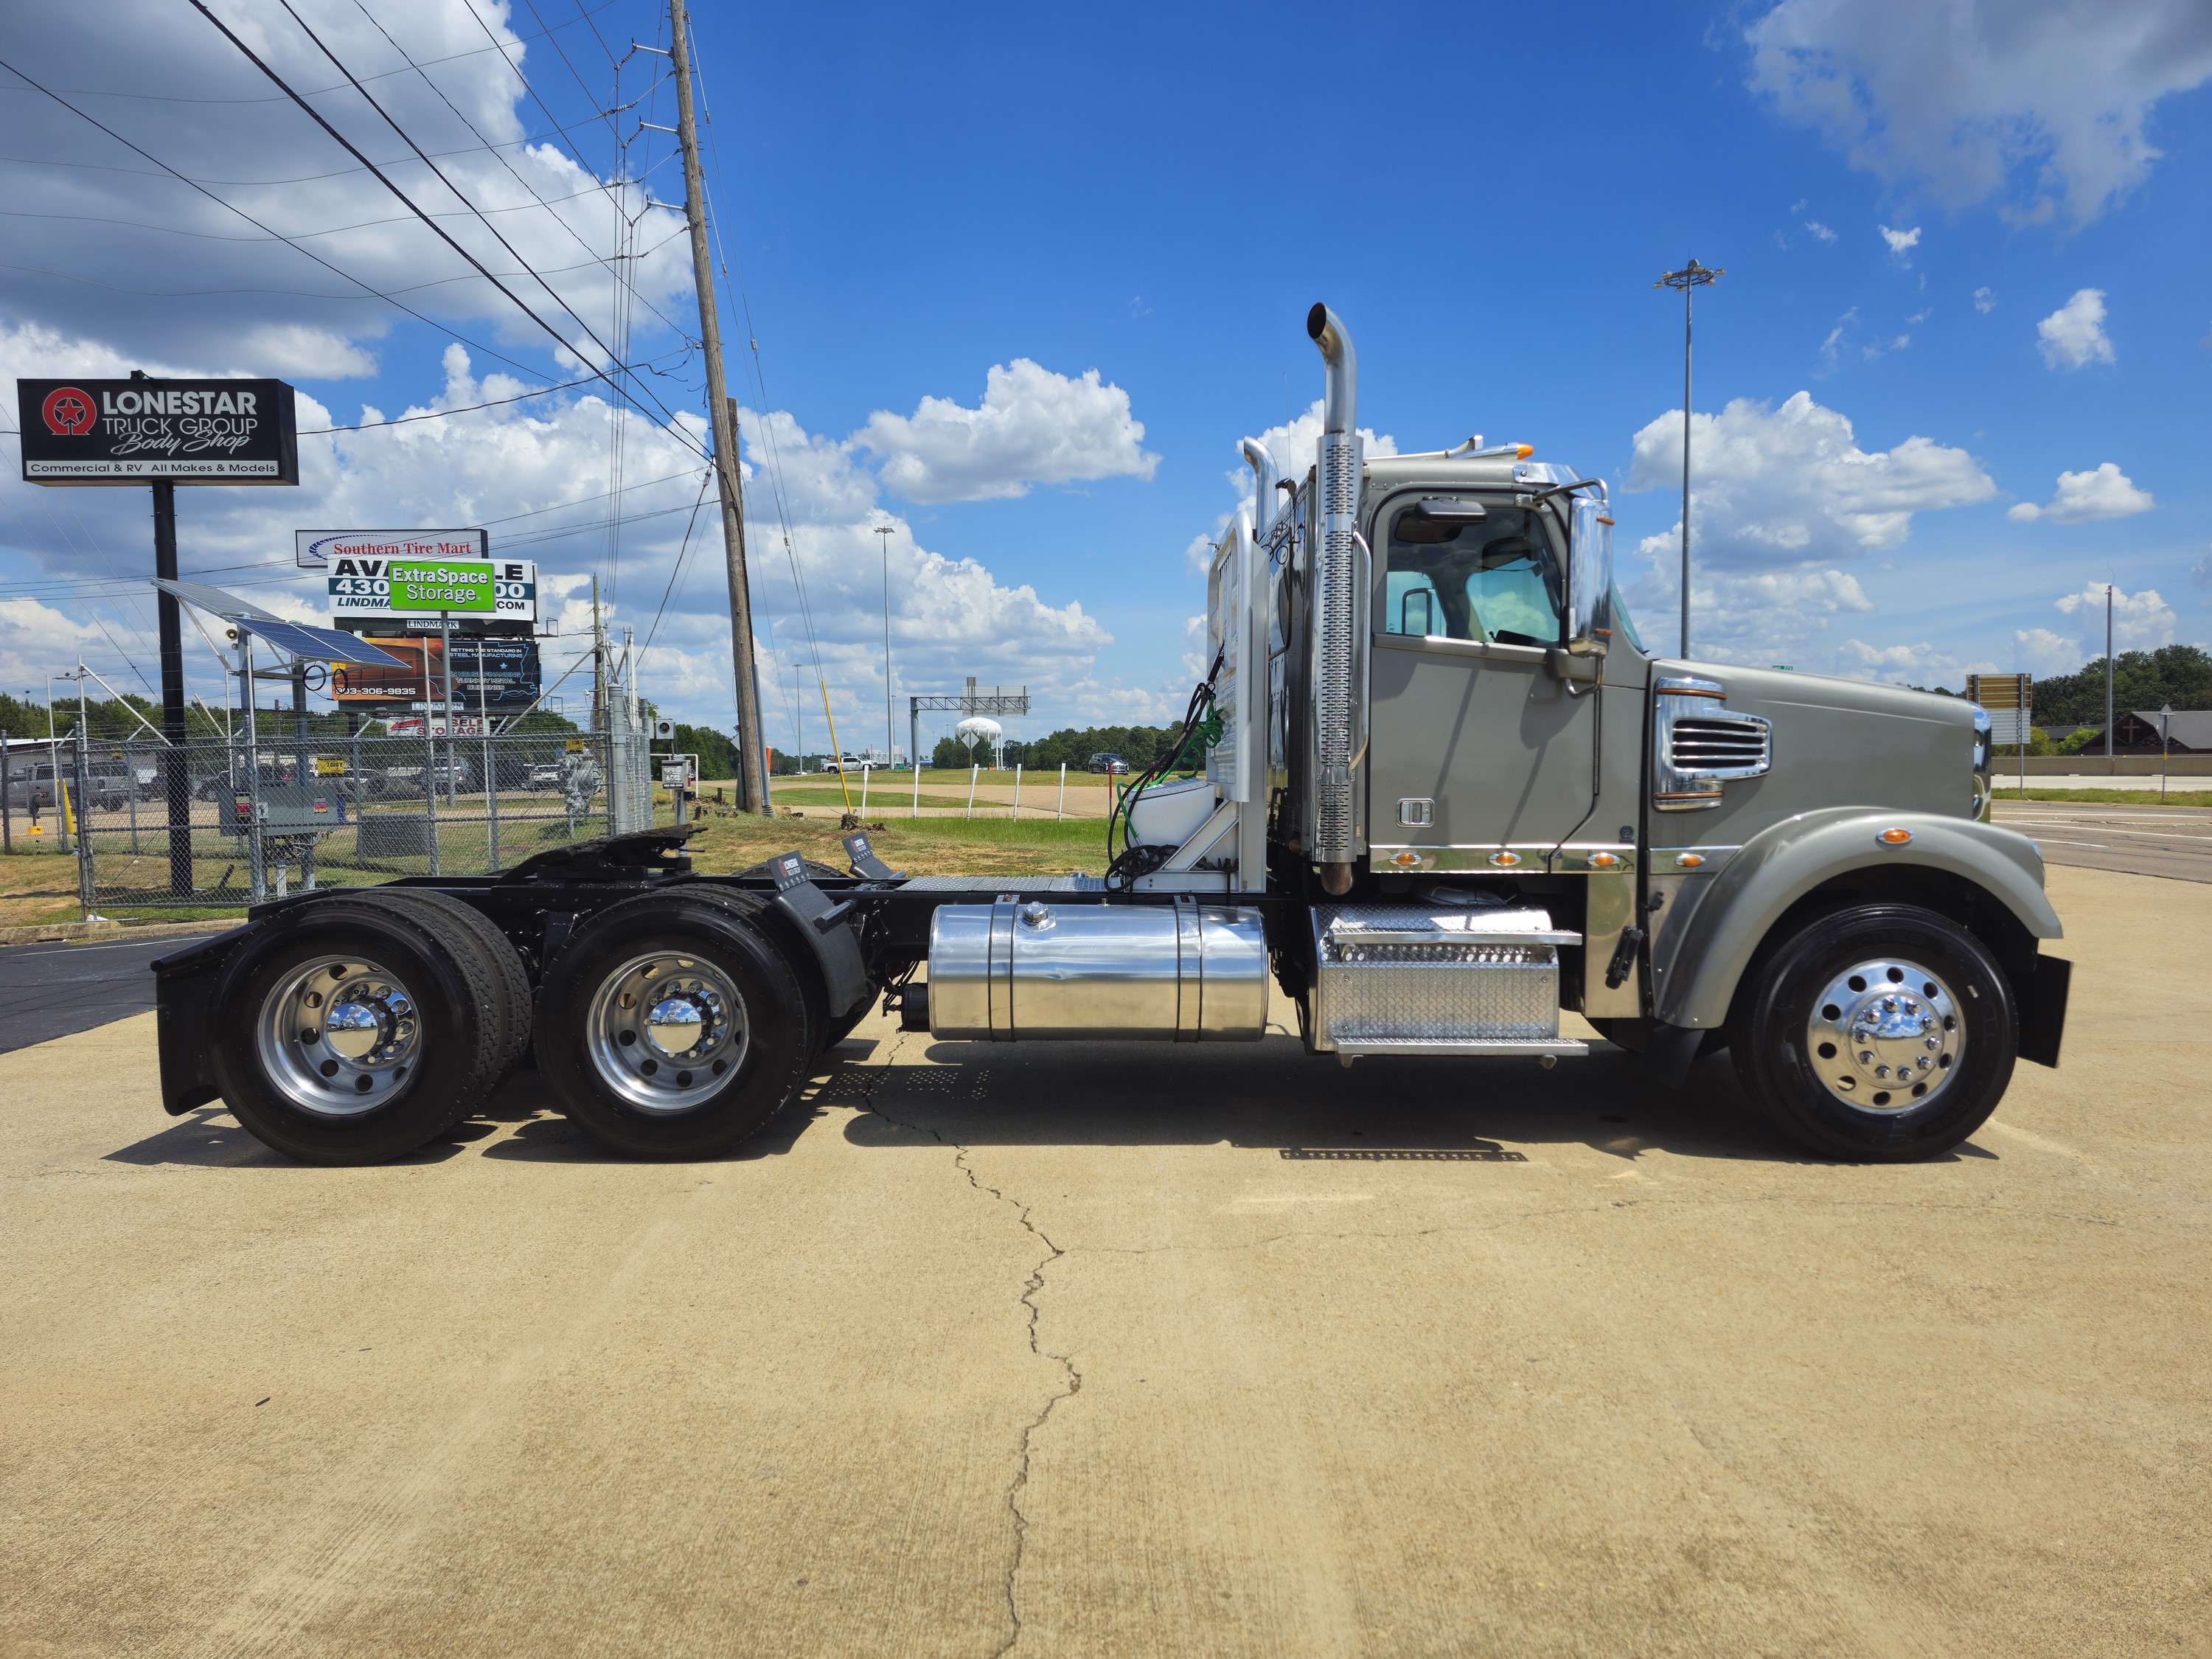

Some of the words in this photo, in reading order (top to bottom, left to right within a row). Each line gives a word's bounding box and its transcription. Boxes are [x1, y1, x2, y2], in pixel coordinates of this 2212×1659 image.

[102, 391, 257, 414] LONESTAR
[102, 417, 173, 435] TRUCK
[179, 417, 258, 435] GROUP
[111, 431, 182, 456] Body
[183, 429, 252, 455] Shop
[31, 464, 110, 473] Commercial
[114, 464, 122, 473] &
[127, 465, 142, 473] RV
[151, 465, 167, 473] All
[171, 465, 212, 473] Makes
[217, 464, 225, 473] &
[229, 464, 275, 473] Models
[334, 543, 400, 554] Southern
[403, 543, 433, 554] Tire
[437, 543, 472, 554] Mart
[406, 584, 476, 603] Storage
[452, 719, 483, 727] SELF
[417, 727, 484, 735] SOAGE
